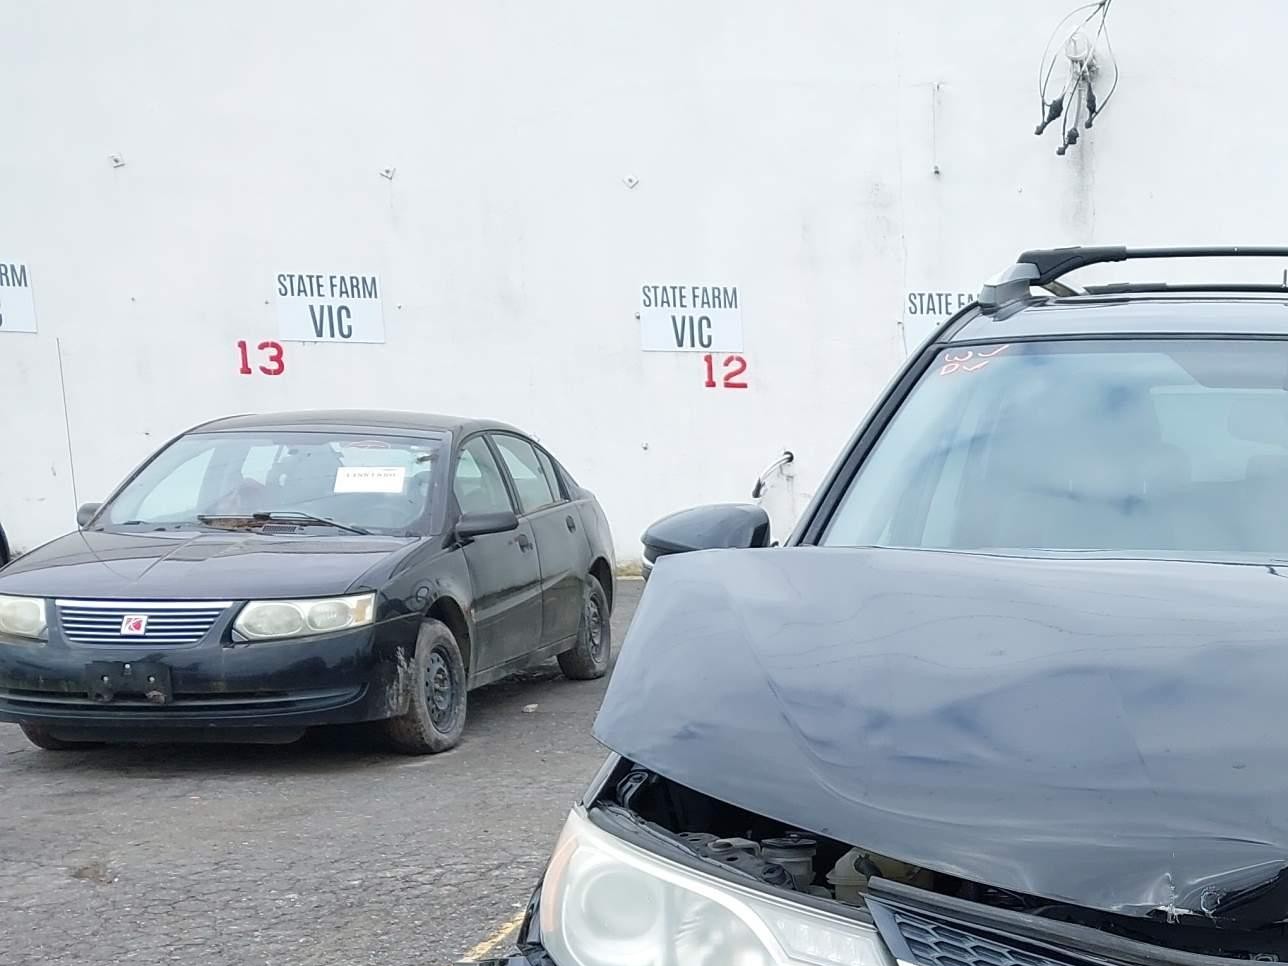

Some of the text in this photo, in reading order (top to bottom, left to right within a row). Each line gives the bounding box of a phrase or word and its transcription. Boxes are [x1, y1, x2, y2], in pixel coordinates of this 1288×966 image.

[277, 273, 379, 300] STATE FARM
[642, 285, 738, 310] STATE FARM
[908, 292, 980, 316] STATE FA
[308, 304, 353, 339] VIC
[671, 315, 713, 349] VIC
[237, 340, 285, 376] 13
[703, 354, 748, 389] 12
